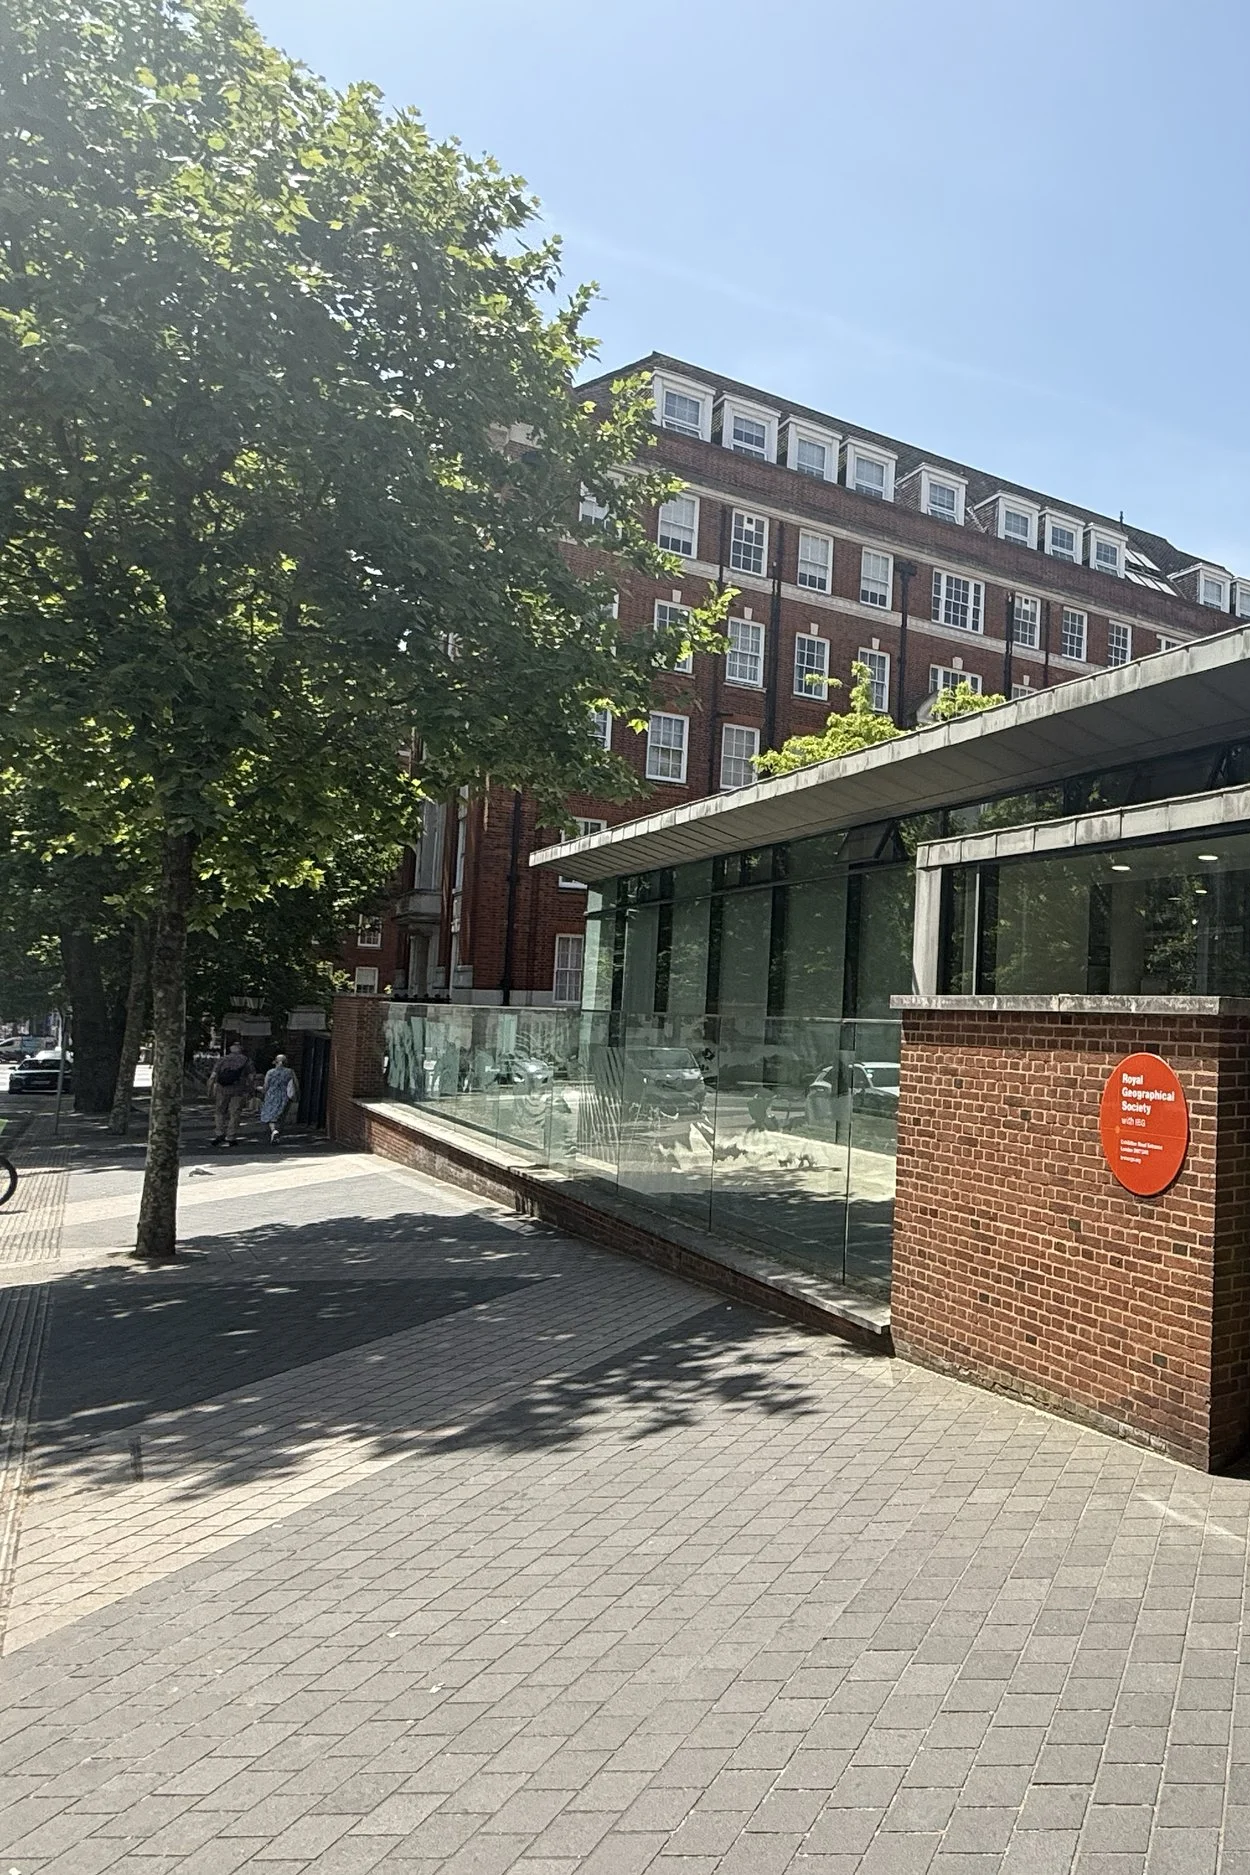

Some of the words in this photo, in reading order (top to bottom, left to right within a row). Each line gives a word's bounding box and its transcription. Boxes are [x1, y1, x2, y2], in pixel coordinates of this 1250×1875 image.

[1122, 1073, 1144, 1086] Royal
[1122, 1087, 1174, 1102] Geographical
[1122, 1100, 1152, 1116] Society
